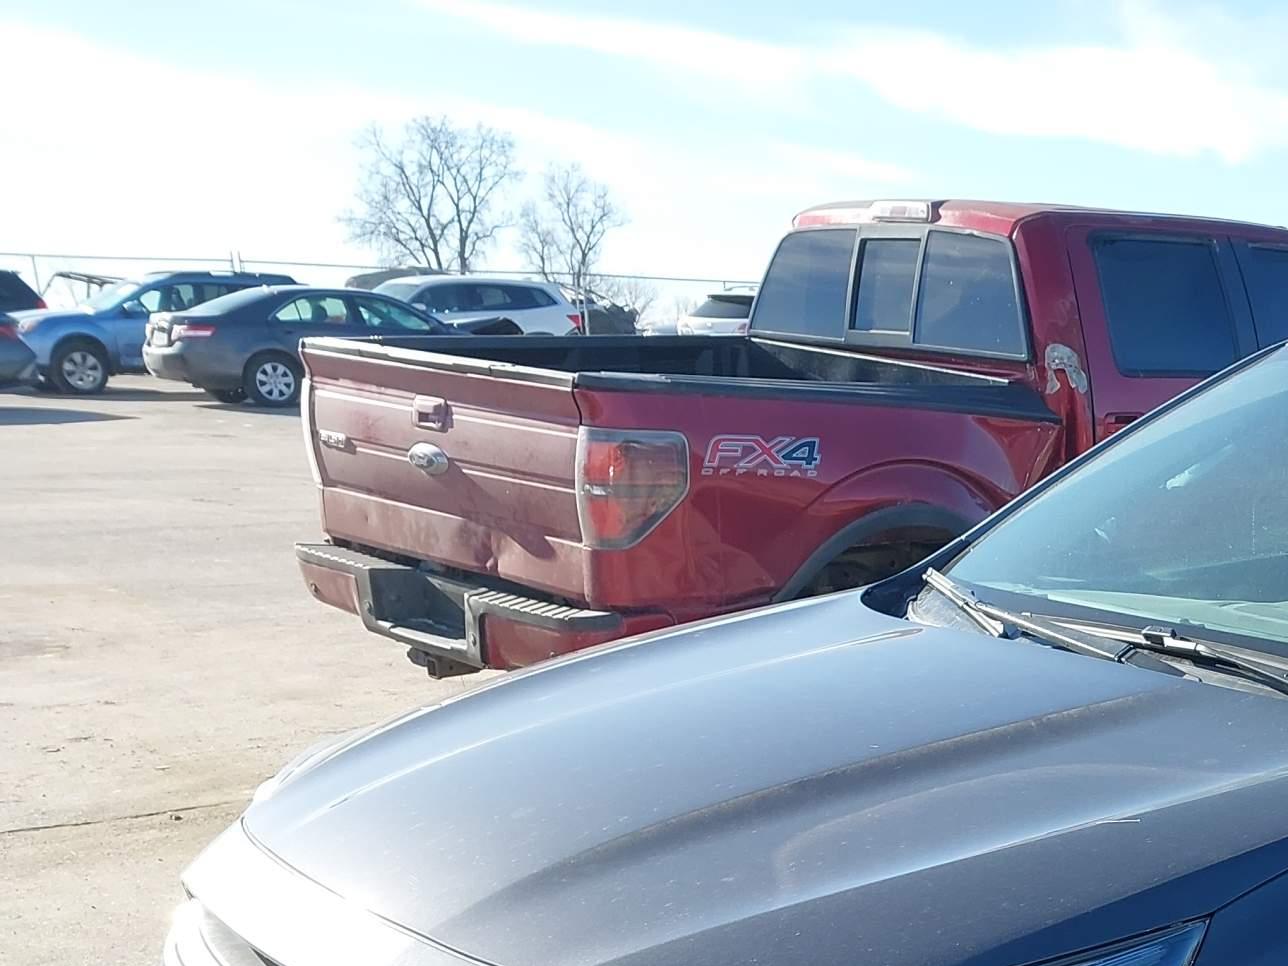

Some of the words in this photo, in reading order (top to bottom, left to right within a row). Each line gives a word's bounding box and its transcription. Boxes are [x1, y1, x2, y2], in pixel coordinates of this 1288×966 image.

[703, 434, 822, 469] FX4
[700, 467, 747, 476] OFF
[756, 468, 818, 477] ROAD
